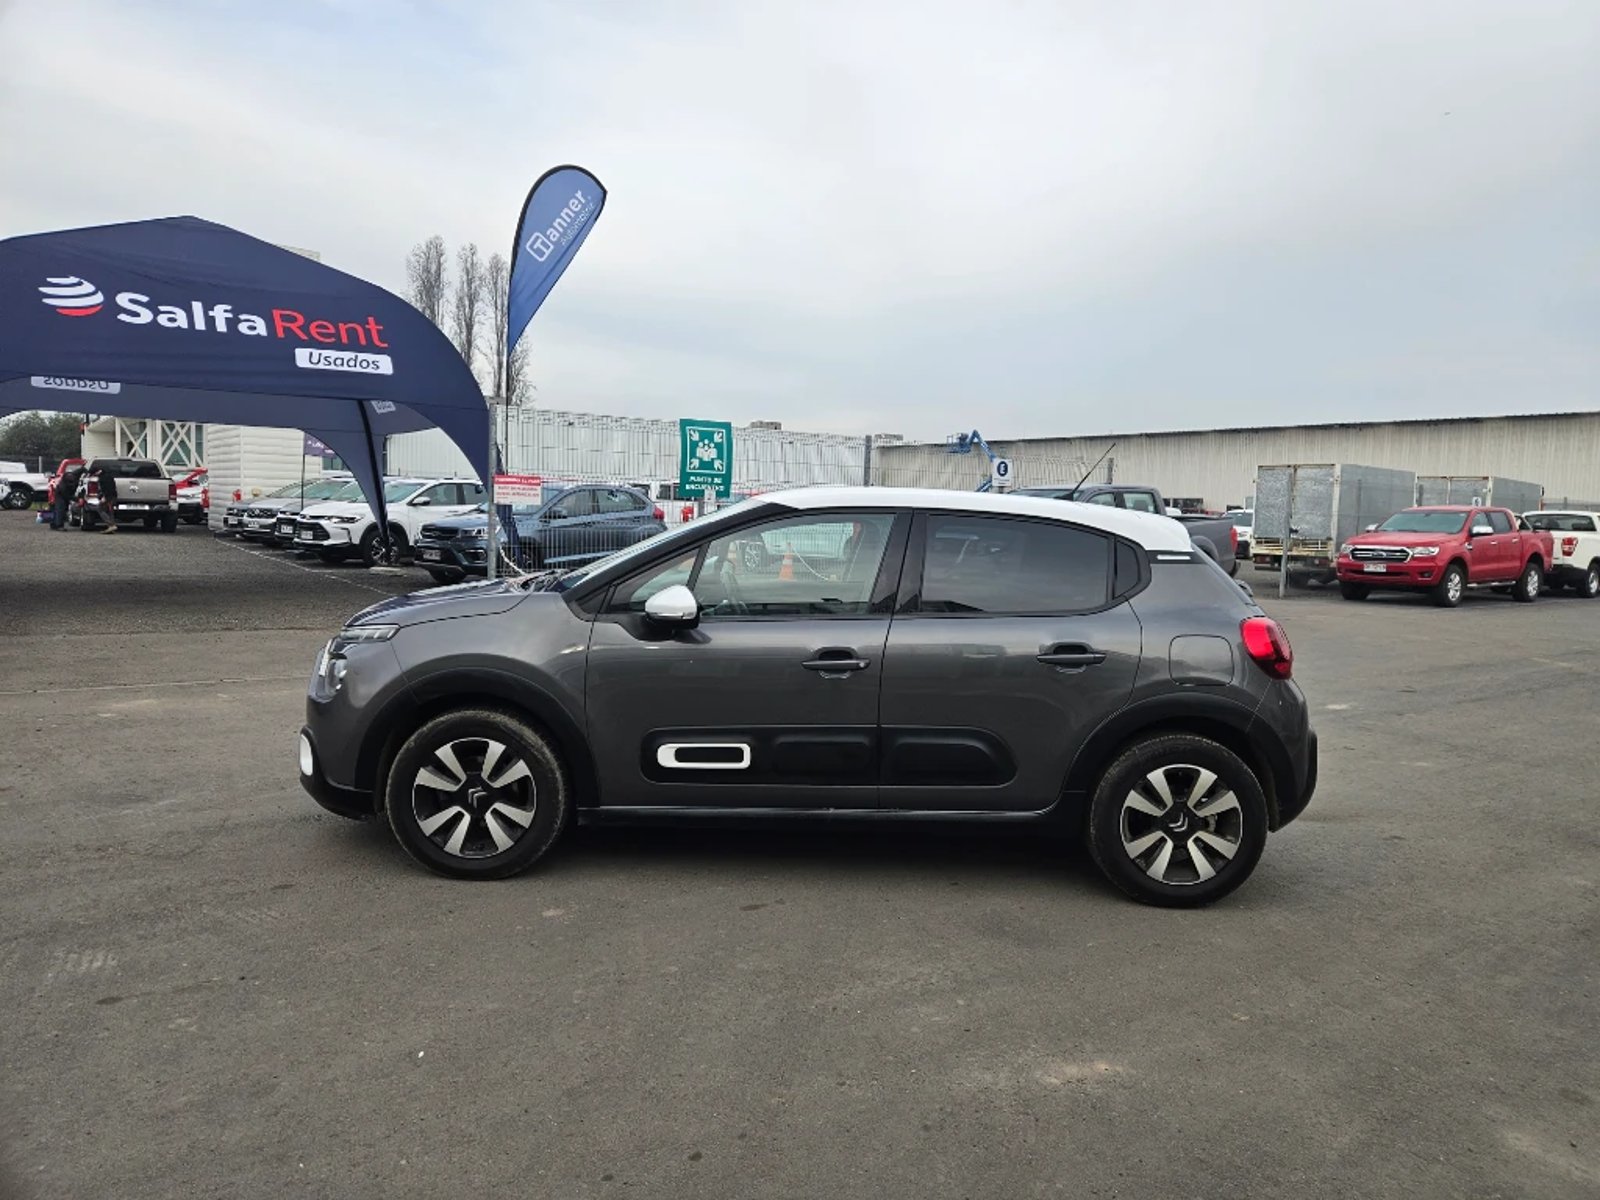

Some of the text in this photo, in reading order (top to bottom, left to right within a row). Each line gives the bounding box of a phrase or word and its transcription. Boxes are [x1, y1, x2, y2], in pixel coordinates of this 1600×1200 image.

[526, 190, 586, 262] Tanner
[115, 291, 388, 348] SalfaRent
[308, 352, 381, 371] Usados
